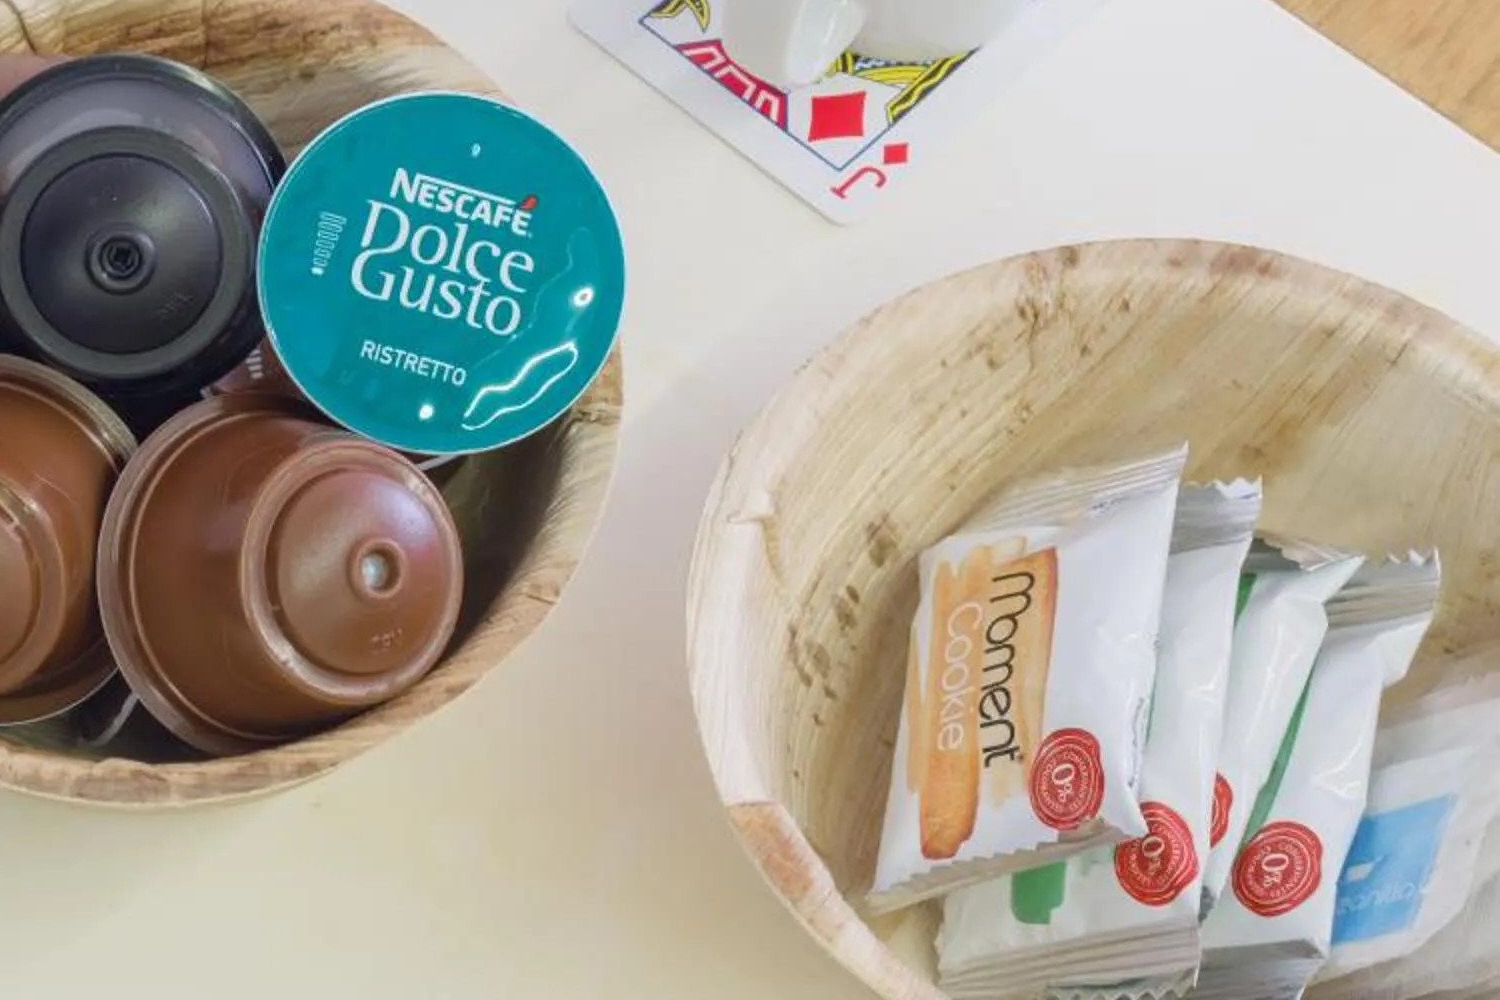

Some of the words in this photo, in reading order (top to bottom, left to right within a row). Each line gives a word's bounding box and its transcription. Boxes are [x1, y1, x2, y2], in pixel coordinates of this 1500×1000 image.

[389, 167, 537, 237] NESCAFÉ
[830, 166, 886, 199] J
[360, 199, 535, 293] Dolce
[351, 264, 521, 336] Gusto
[359, 339, 468, 386] RISTRETTO
[936, 602, 983, 752] Cookie
